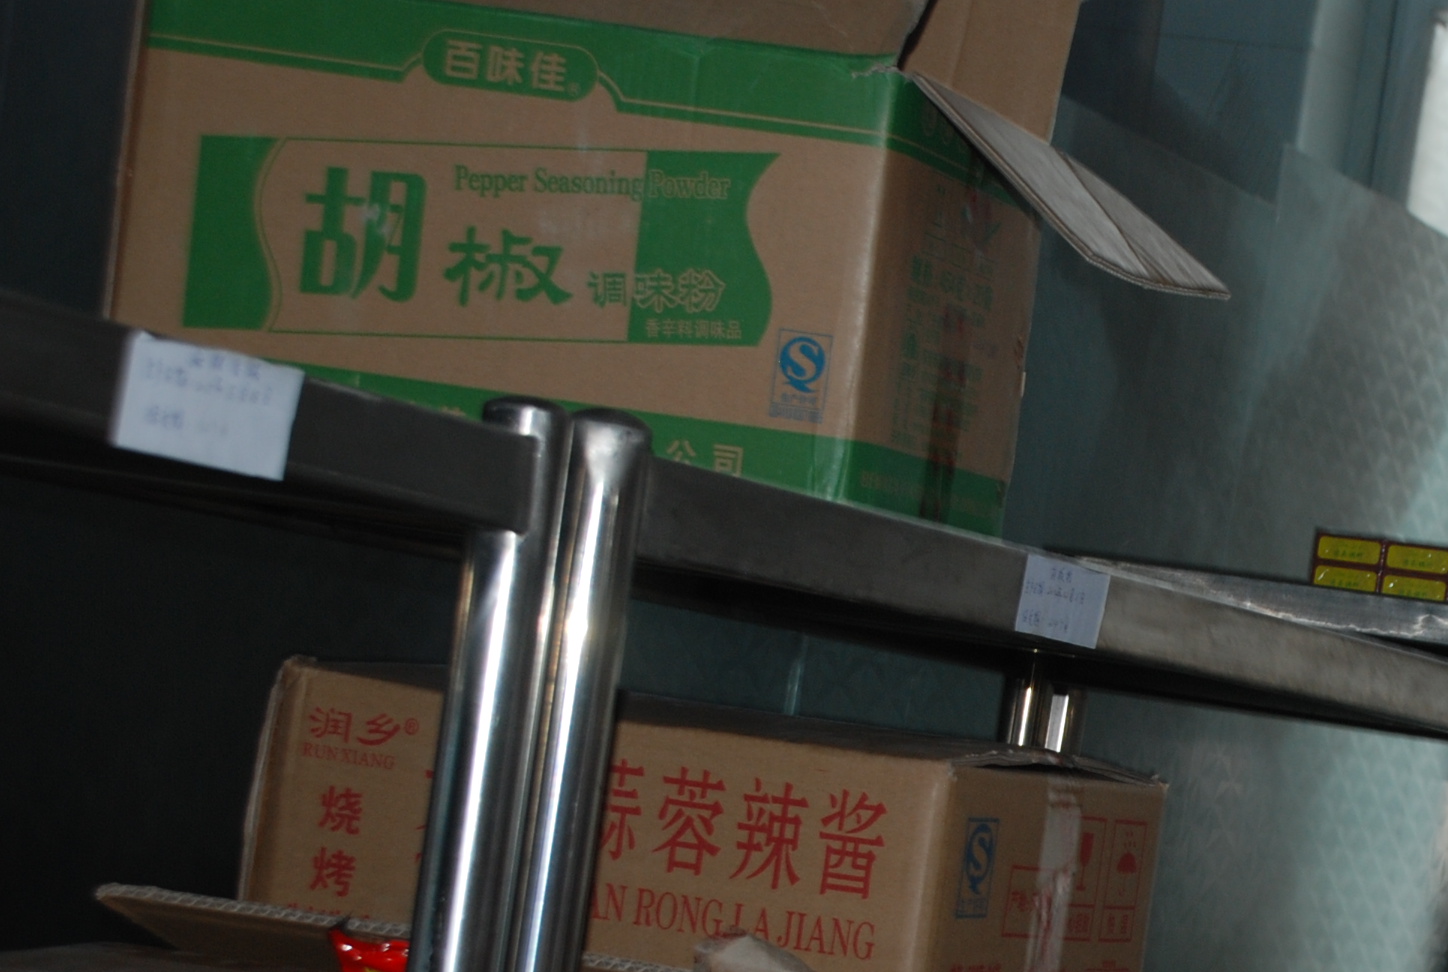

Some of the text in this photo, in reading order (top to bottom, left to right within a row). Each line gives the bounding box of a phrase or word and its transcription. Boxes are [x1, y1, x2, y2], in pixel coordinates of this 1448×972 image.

[445, 38, 567, 93] 百味佳
[454, 165, 731, 202] Pepper Seasoning Powder
[298, 166, 723, 315] 胡椒 调味粉
[644, 317, 742, 340] 香辛料调味品
[308, 706, 401, 747] 润乡
[633, 887, 724, 938] RONG
[776, 909, 876, 961] JIANG
